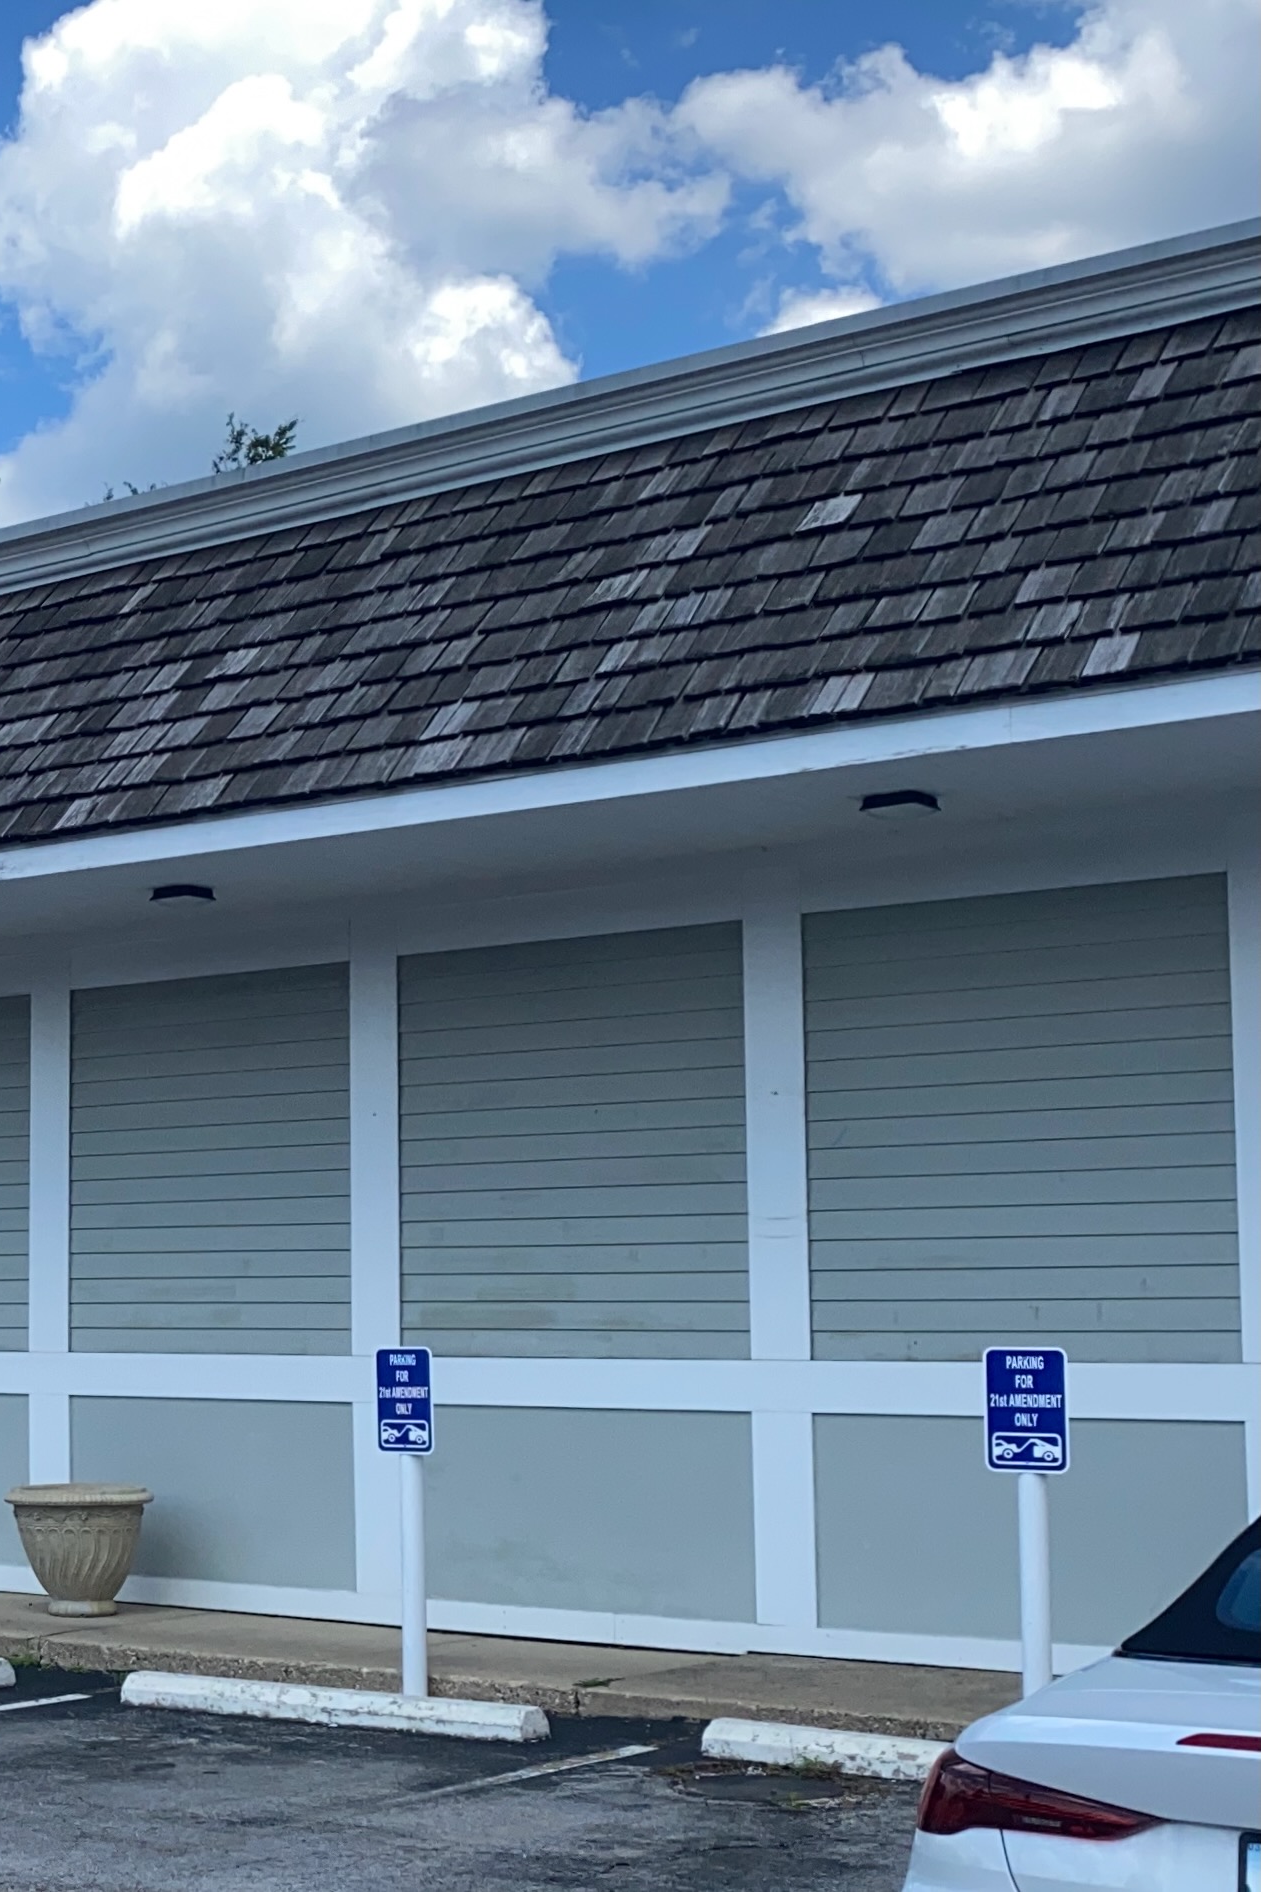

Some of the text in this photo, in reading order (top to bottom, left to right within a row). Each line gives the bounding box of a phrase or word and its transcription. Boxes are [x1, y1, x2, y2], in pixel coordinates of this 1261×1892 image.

[389, 1354, 416, 1366] PARKING
[1005, 1355, 1045, 1370] PARKING
[395, 1370, 409, 1382] FOR
[1015, 1375, 1034, 1389] FOR
[391, 1387, 428, 1399] AMENDMENT
[990, 1394, 1063, 1408] 21st AMENDMENT
[395, 1403, 412, 1415] ONLY
[1014, 1413, 1039, 1427] ONLY
